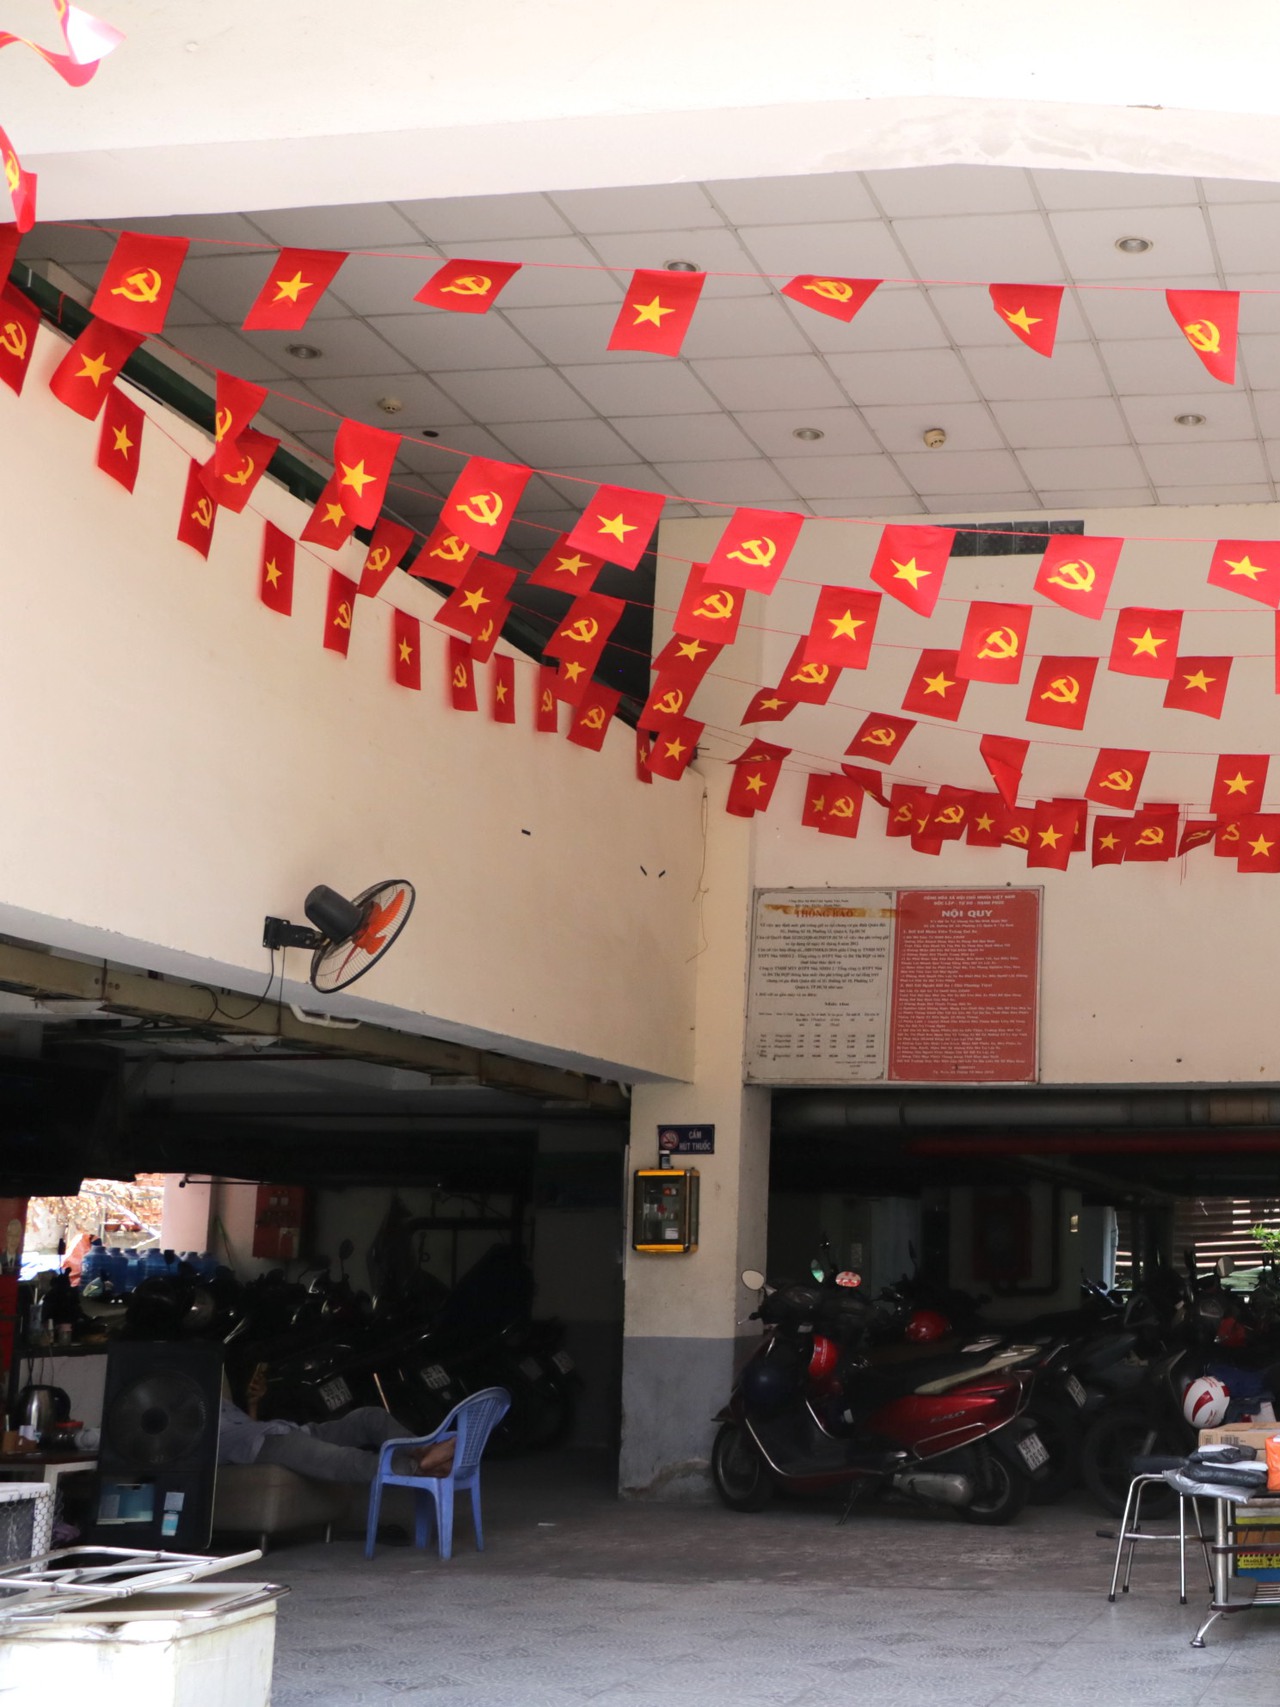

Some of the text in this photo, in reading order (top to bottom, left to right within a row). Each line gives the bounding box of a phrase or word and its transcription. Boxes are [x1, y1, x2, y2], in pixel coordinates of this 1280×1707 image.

[941, 908, 993, 918] NỘI QUY
[688, 1128, 702, 1139] CẤM
[679, 1140, 691, 1150] HÚT
